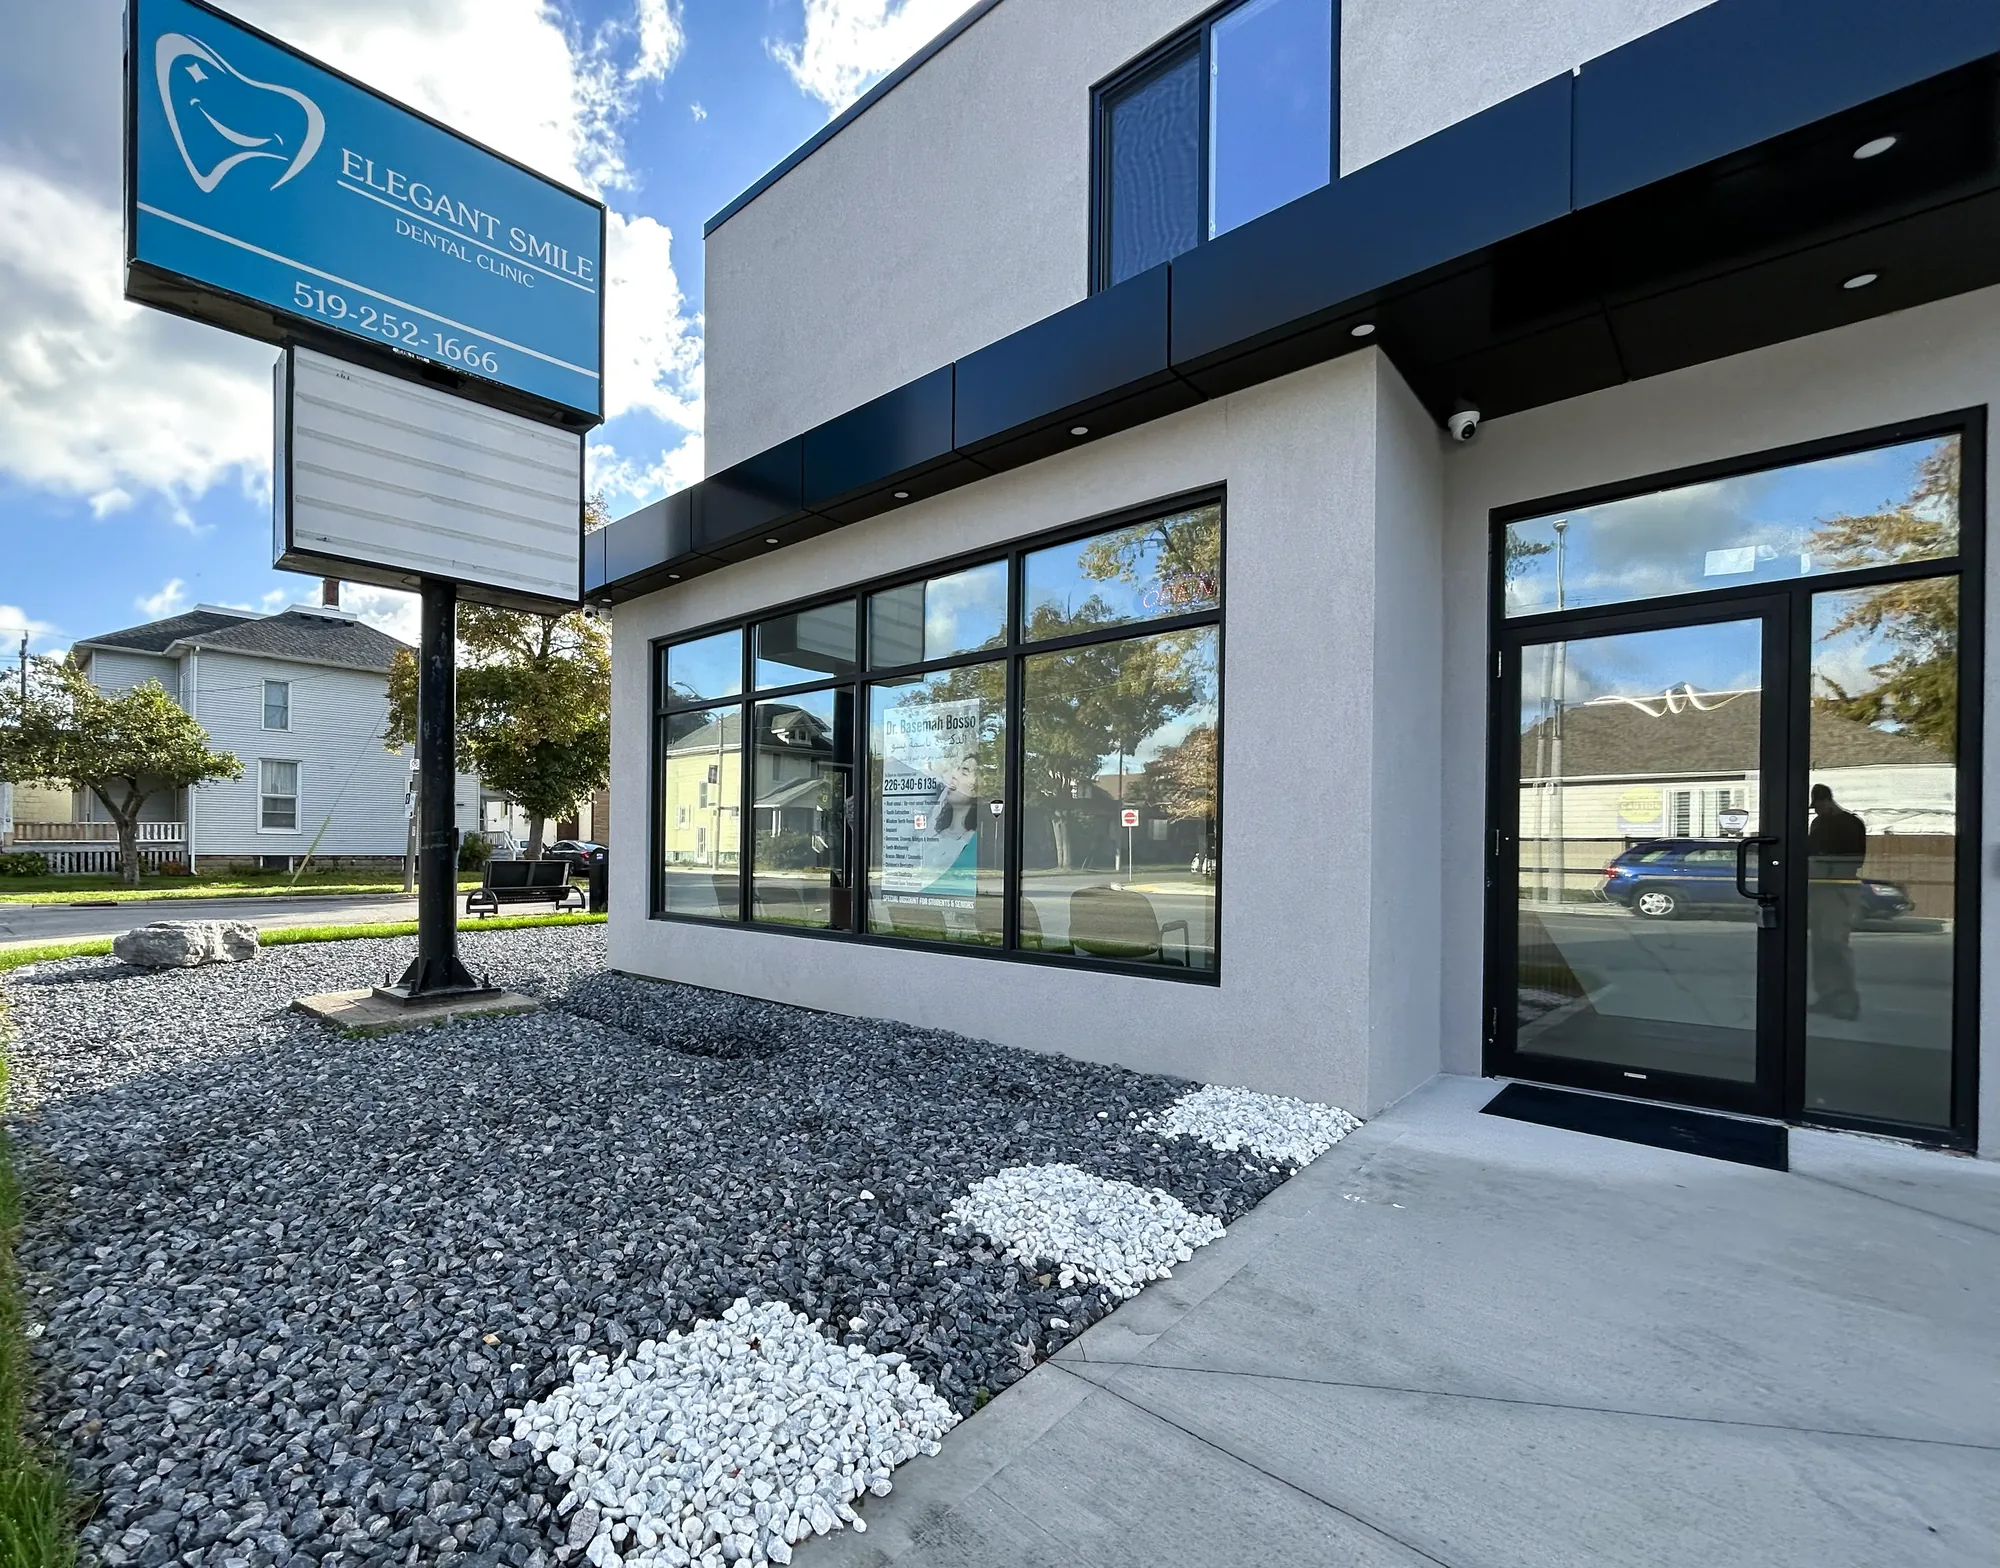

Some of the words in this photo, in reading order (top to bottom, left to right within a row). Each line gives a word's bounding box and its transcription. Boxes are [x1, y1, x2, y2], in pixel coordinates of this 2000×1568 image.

[342, 148, 501, 241] ELEGANT
[508, 226, 594, 283] SMILE
[396, 218, 472, 263] DENTAL
[476, 254, 535, 288] CLINIC
[293, 281, 499, 374] 519-252-1666
[886, 720, 898, 735] Dr.
[900, 717, 944, 735] Basemah
[945, 713, 976, 730] Bosso
[884, 777, 937, 791] 226-340-6135
[882, 894, 899, 903] SPECIAL
[899, 895, 920, 905] DISCOUNT
[920, 897, 928, 906] FOR
[928, 898, 951, 908] STUDENTS
[955, 900, 975, 910] SENIORS
